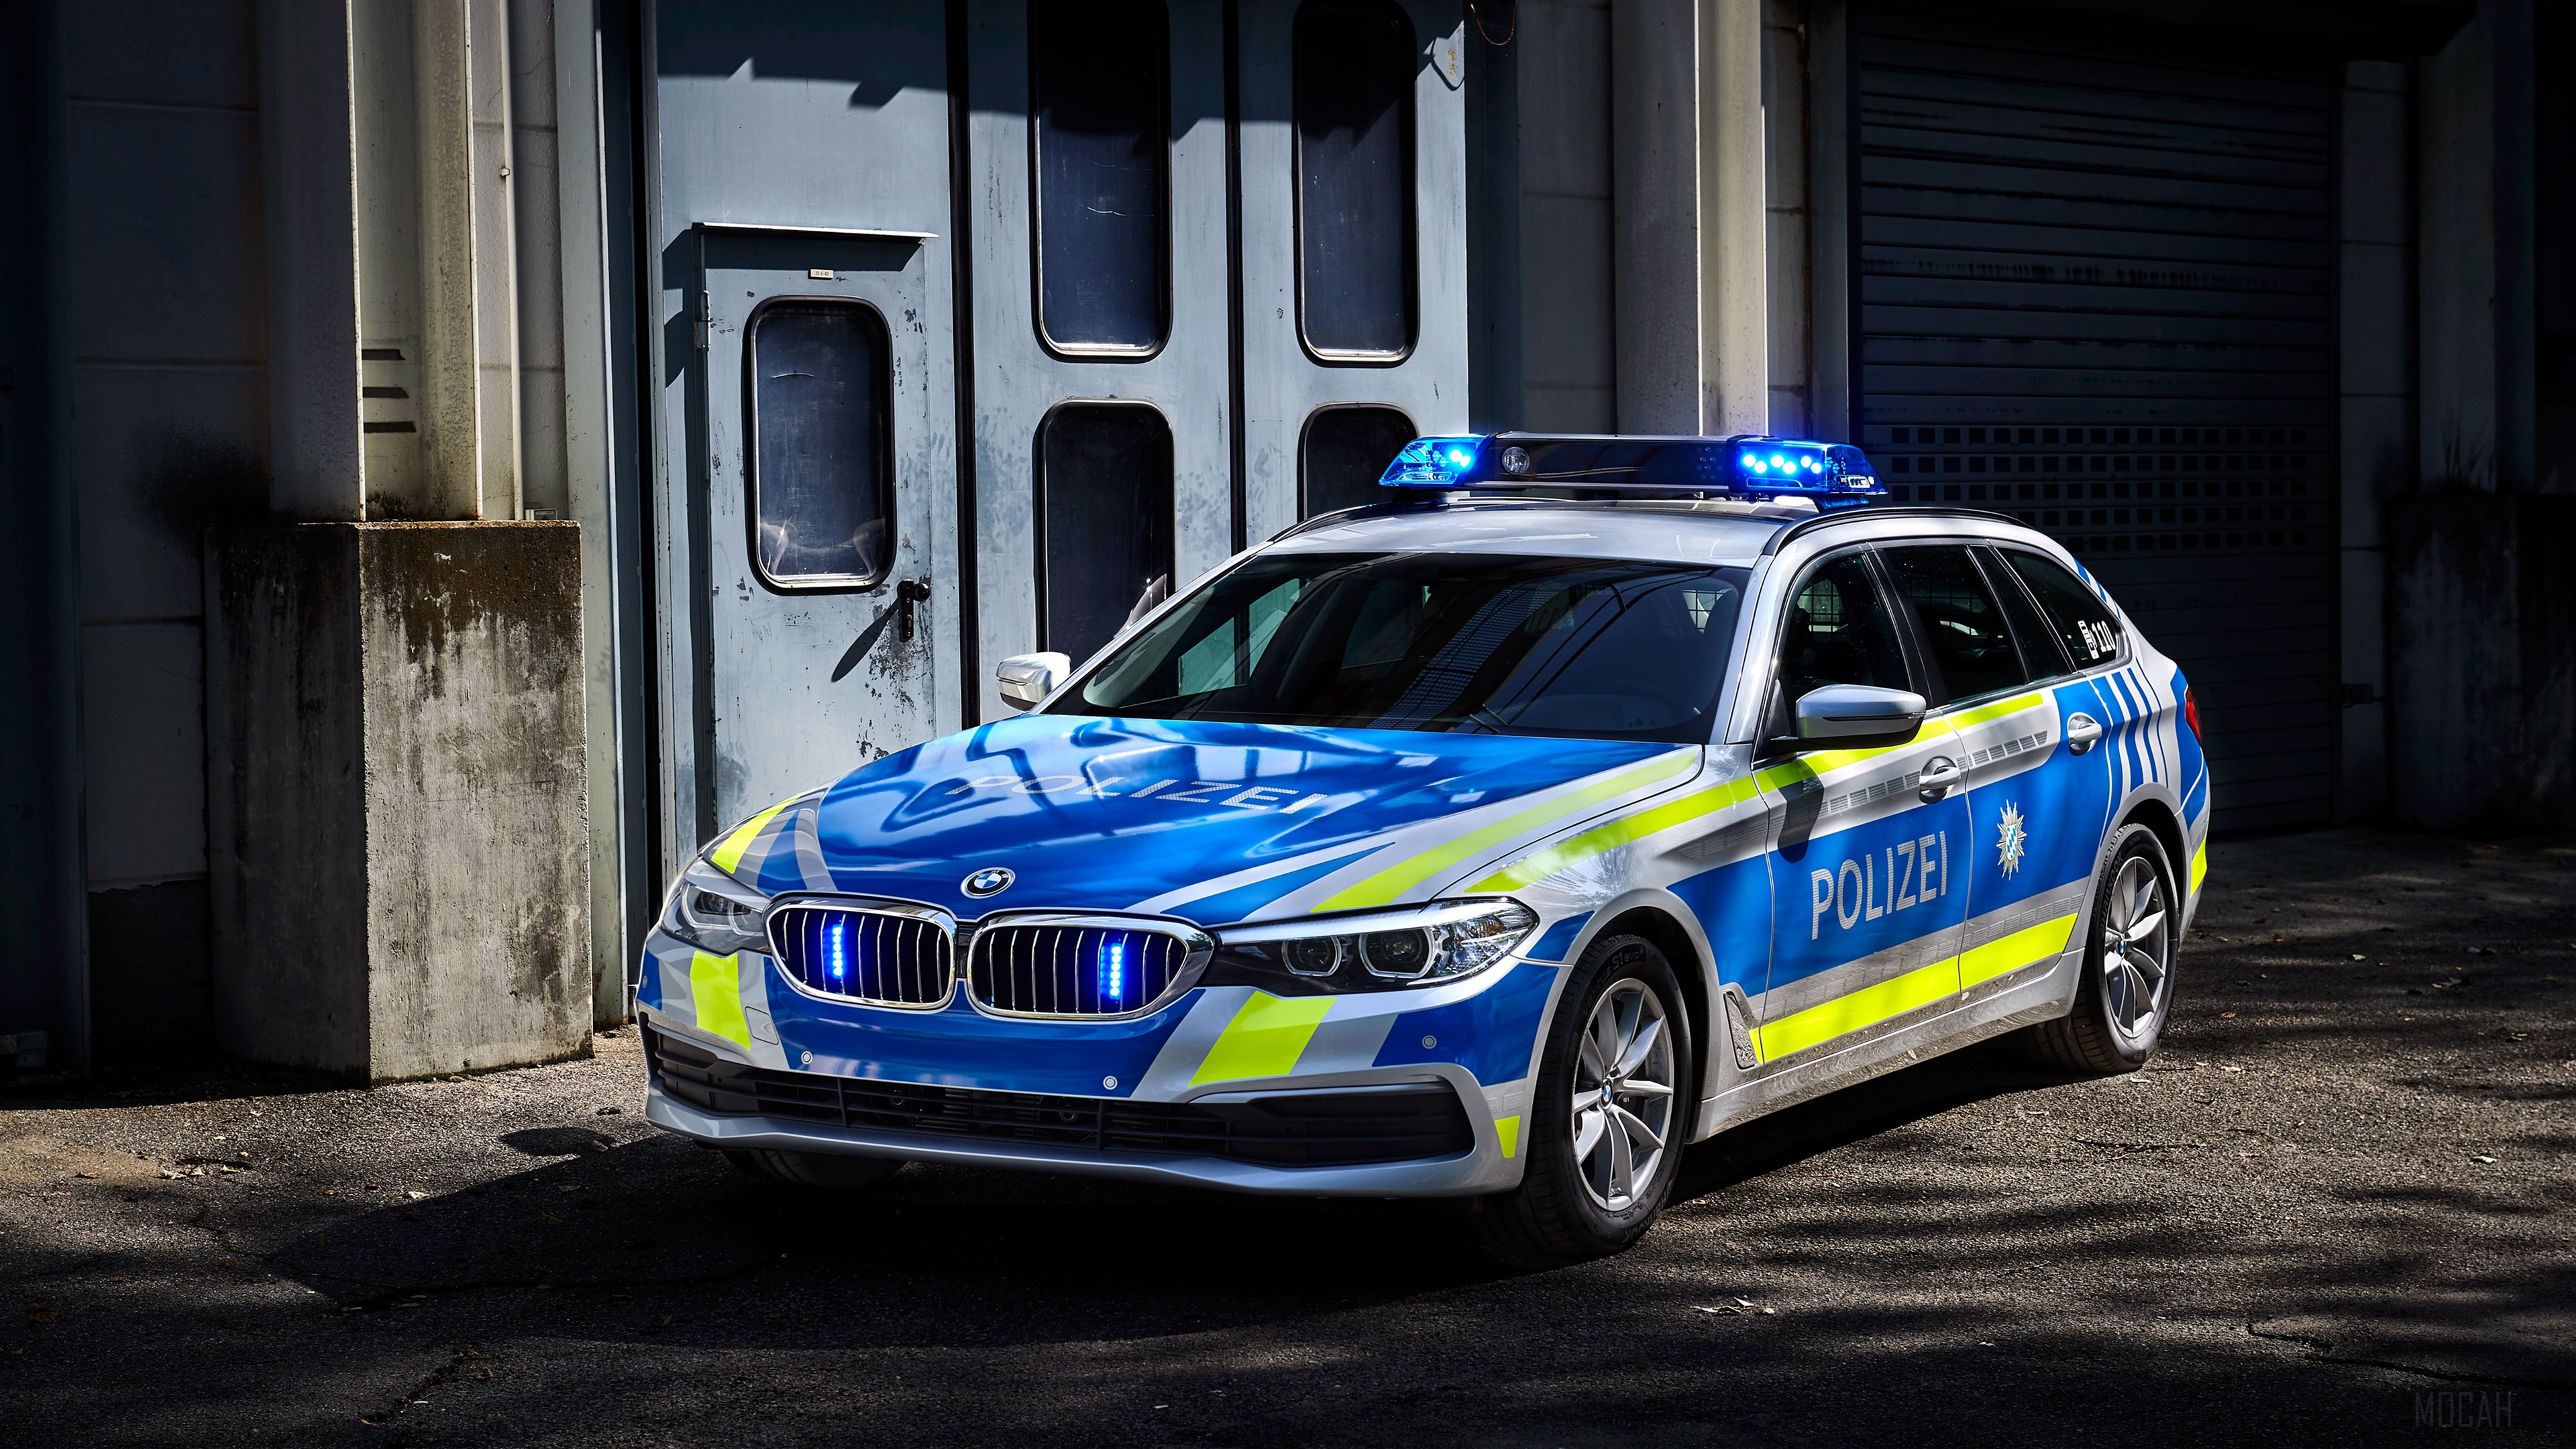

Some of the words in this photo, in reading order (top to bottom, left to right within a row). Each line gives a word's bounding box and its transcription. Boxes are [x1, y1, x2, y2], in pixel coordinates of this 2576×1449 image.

[2091, 621, 2116, 653] 110
[945, 775, 1327, 814] POLIZEI
[1811, 830, 1947, 940] POLIZEI
